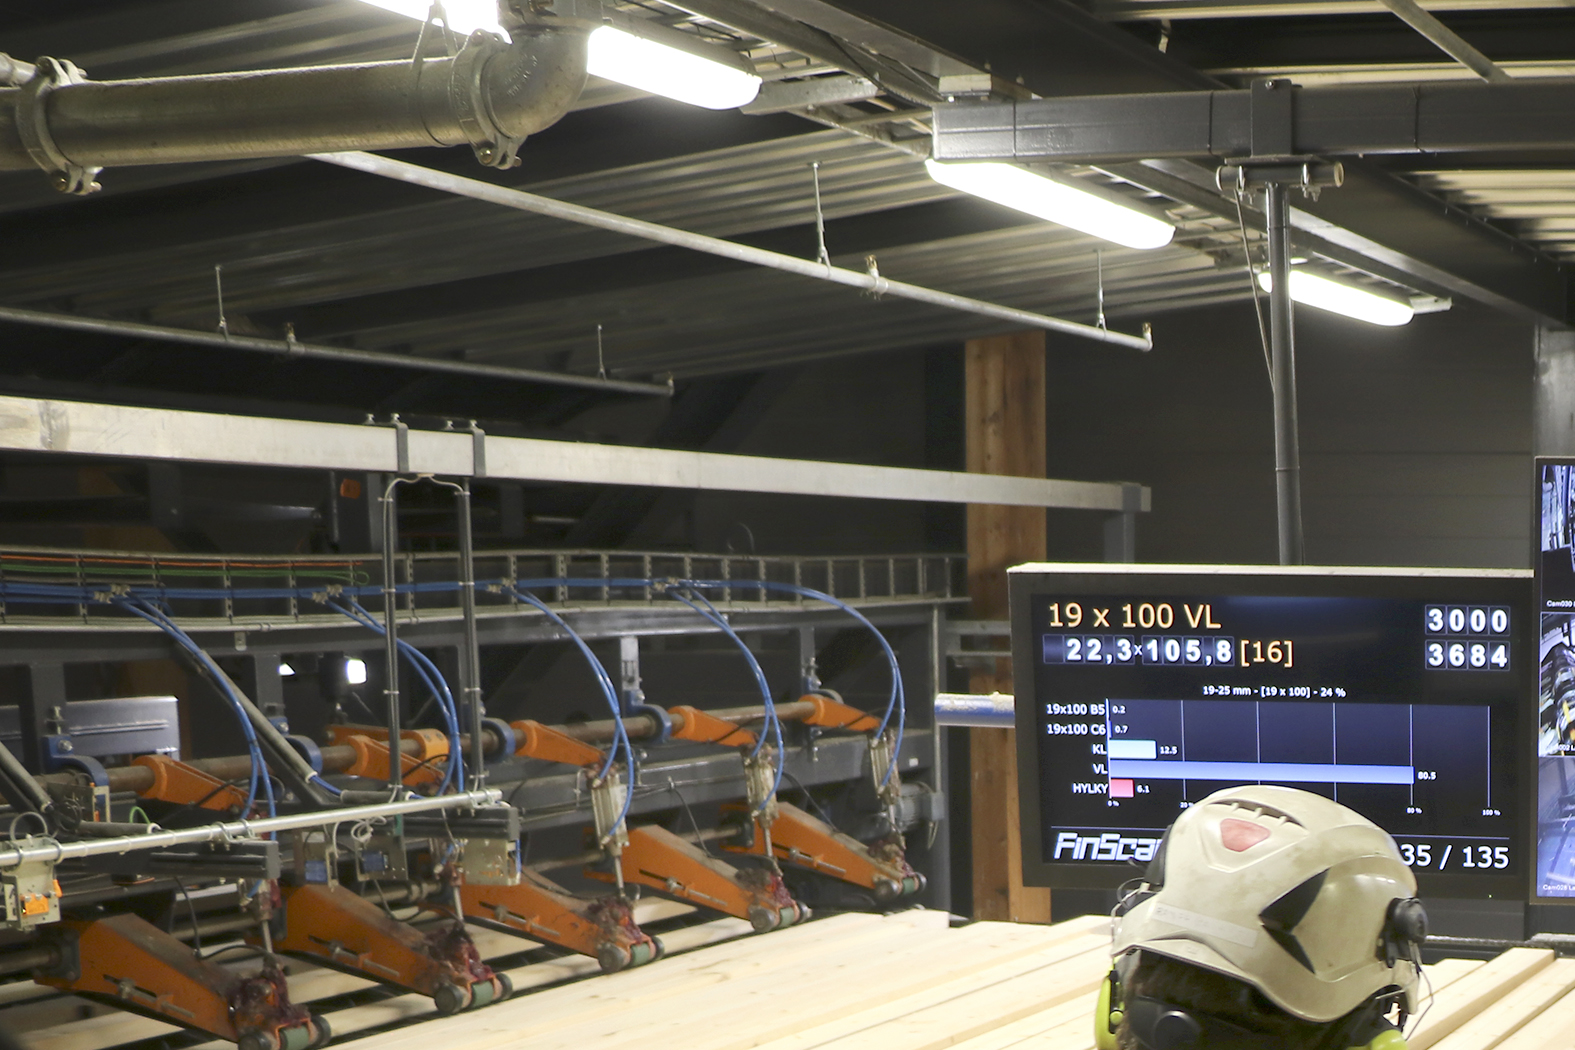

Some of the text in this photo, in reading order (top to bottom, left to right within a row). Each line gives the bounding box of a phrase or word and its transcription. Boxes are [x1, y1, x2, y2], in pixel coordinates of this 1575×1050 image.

[1049, 603, 1222, 629] 19 x 100 VL
[1428, 608, 1508, 633] 3000
[1240, 640, 1293, 667] [16]
[1428, 643, 1508, 668] 3684
[1203, 685, 1231, 695] 19-25
[1233, 688, 1251, 696] mm
[1261, 686, 1278, 698] [19
[1289, 686, 1311, 698] 100]
[1320, 687, 1333, 697] 24
[1046, 704, 1088, 715] 19x100
[1112, 706, 1126, 714] 0.2
[1047, 724, 1106, 735] 19x100 C6
[1092, 744, 1107, 754] KL
[1160, 746, 1178, 754] 12.5
[1093, 763, 1108, 774] VL
[1418, 771, 1437, 780] 80.5
[1073, 783, 1108, 794] HYLKY
[1137, 785, 1150, 793] 6.1
[1054, 833, 1162, 861] FinSca
[1463, 846, 1509, 869] 135
